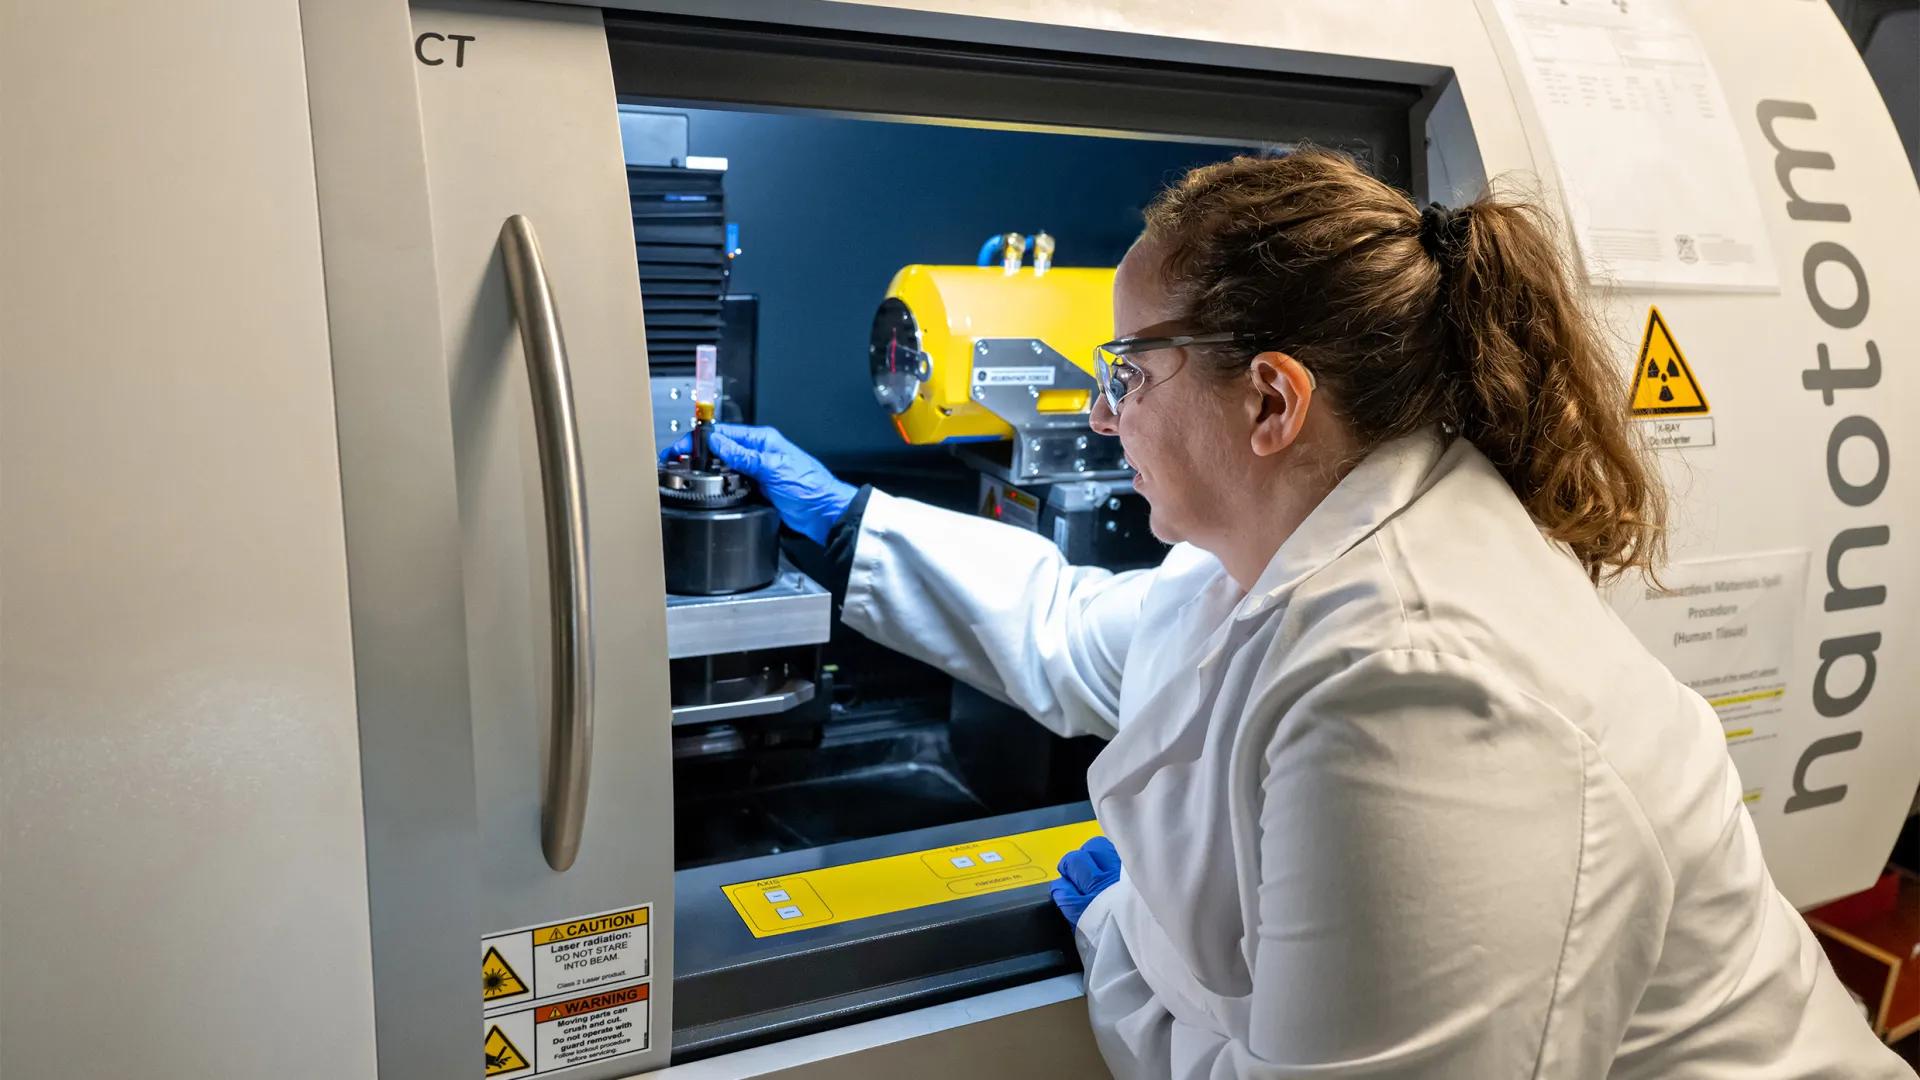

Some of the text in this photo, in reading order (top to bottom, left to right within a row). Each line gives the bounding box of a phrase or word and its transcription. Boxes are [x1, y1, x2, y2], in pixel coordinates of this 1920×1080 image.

[415, 32, 476, 68] CT
[1756, 98, 1891, 815] nanotom
[1645, 584, 1712, 600] Bioardous
[1688, 603, 1738, 619] Procedure
[1673, 631, 1712, 648] (Human
[757, 879, 780, 887] AXIS
[566, 913, 635, 936] CAUTION
[551, 931, 631, 953] Laser radiation:
[555, 941, 628, 963] DO NOT STARE
[564, 959, 587, 970] INTO
[557, 981, 575, 989] Class
[582, 976, 600, 984] Laser
[565, 989, 638, 1014] WARNING
[557, 1007, 628, 1027] Moving parts can
[552, 1021, 632, 1045] Do not operate with
[563, 1024, 588, 1034] crush
[589, 1020, 605, 1029] and
[554, 1050, 575, 1060] Follow
[600, 1038, 631, 1050] procedure
[561, 1040, 585, 1053] guard
[567, 1053, 588, 1063] before
